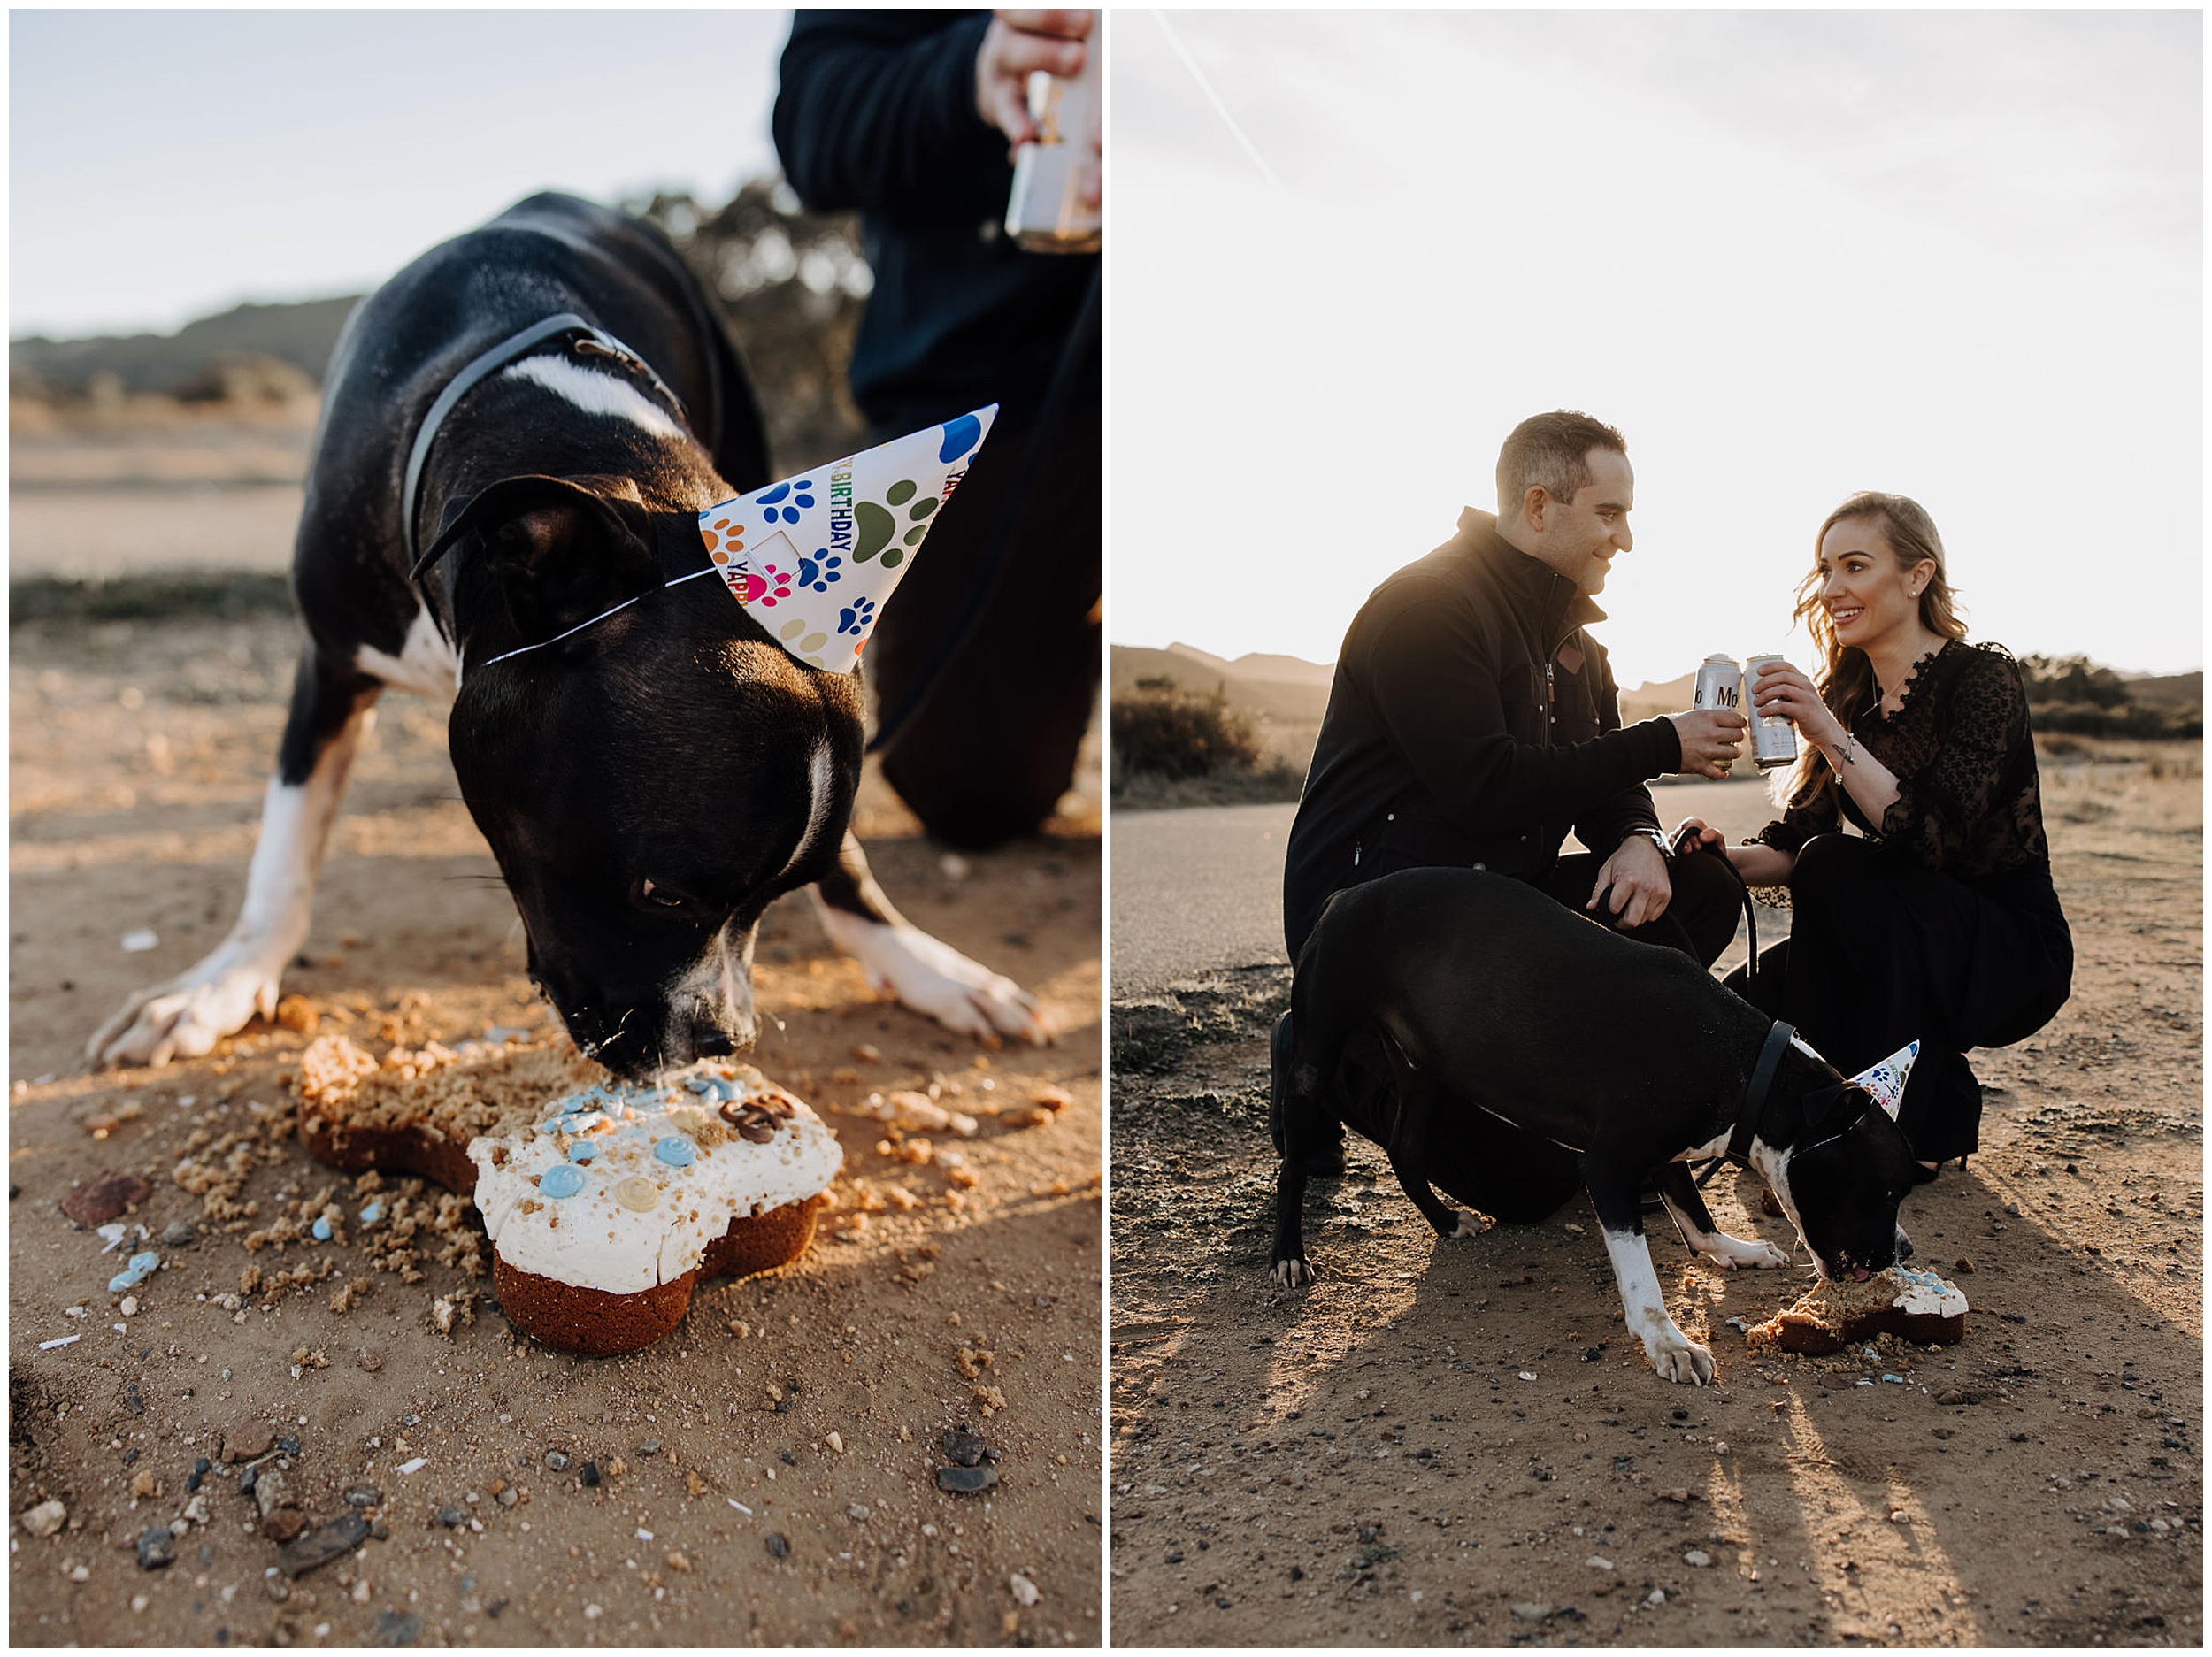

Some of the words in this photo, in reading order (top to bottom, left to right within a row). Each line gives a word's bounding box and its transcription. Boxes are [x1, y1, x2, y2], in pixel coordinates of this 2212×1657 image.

[830, 471, 852, 551] BIRTHDAY
[727, 561, 749, 606] YAPP
[1717, 686, 1739, 708] Mo
